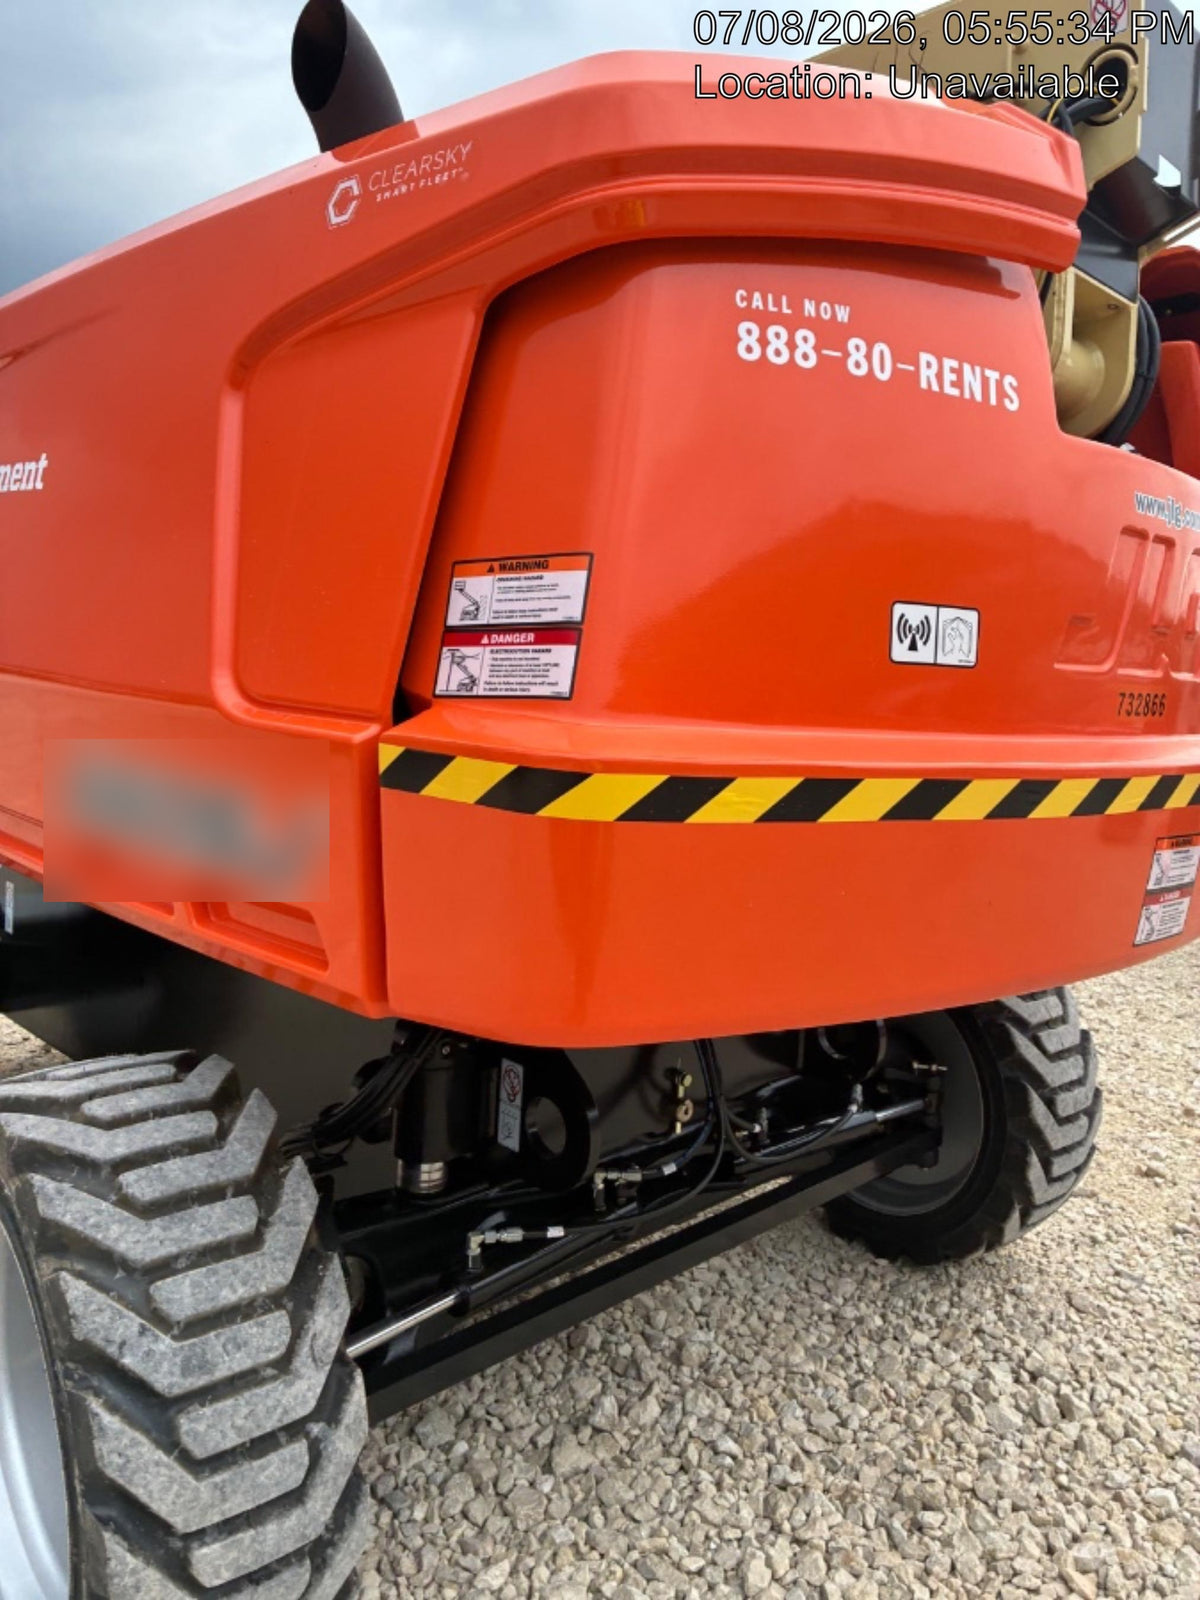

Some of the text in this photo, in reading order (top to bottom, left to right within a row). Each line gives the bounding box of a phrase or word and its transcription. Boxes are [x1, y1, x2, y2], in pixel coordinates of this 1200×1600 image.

[368, 140, 472, 191] CLEARSKY
[376, 183, 415, 202] SMART
[735, 289, 851, 323] CALL NOW
[497, 559, 550, 573] WARNING
[490, 632, 535, 645] DANGER
[1117, 692, 1166, 717] 732866
